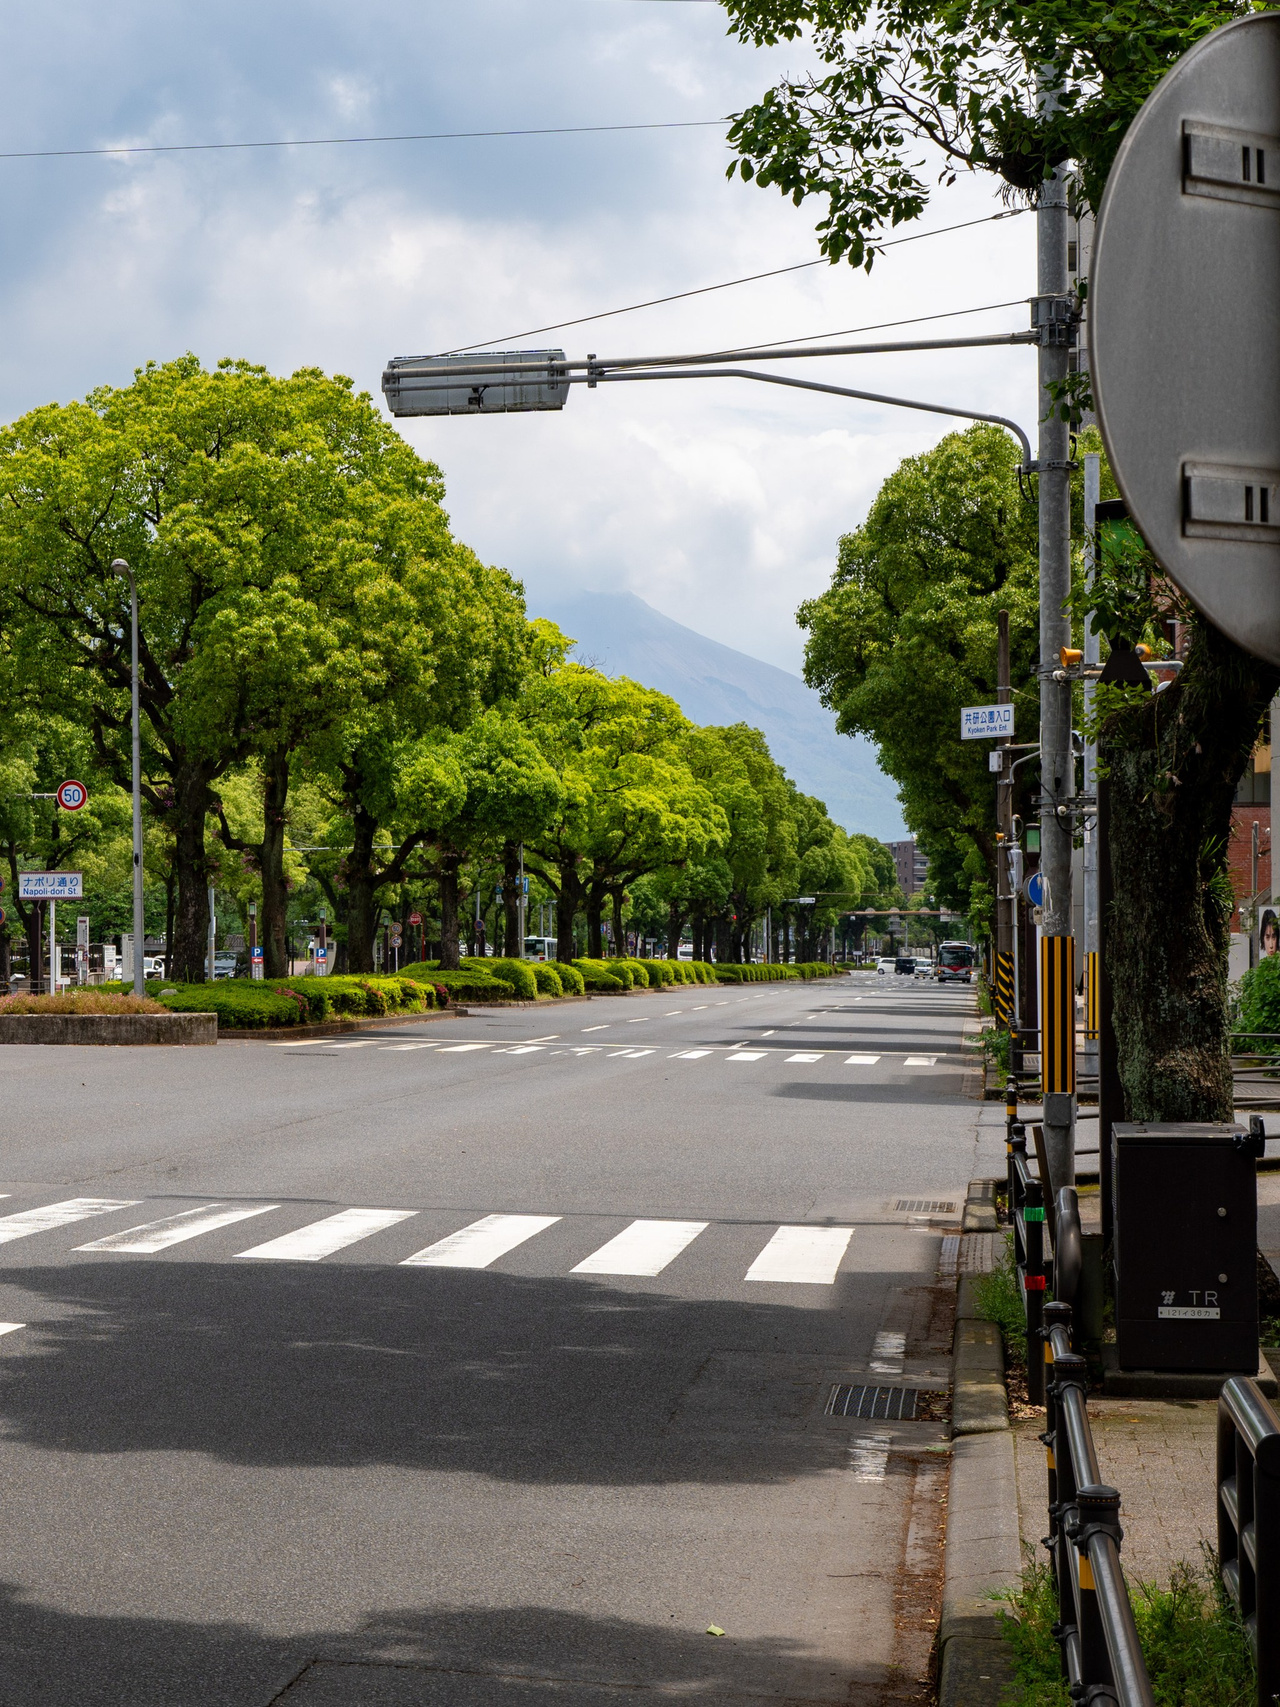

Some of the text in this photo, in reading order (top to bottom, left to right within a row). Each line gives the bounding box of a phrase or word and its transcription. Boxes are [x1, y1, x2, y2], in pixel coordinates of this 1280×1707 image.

[965, 710, 1010, 725] 共研公園入口
[968, 726, 985, 735] Kyoken
[987, 724, 997, 732] Park
[64, 789, 80, 802] 50
[23, 877, 79, 887] ナポリ通り
[23, 887, 78, 896] Napoli-dori St.
[254, 948, 261, 956] P
[1188, 1290, 1219, 1306] TR
